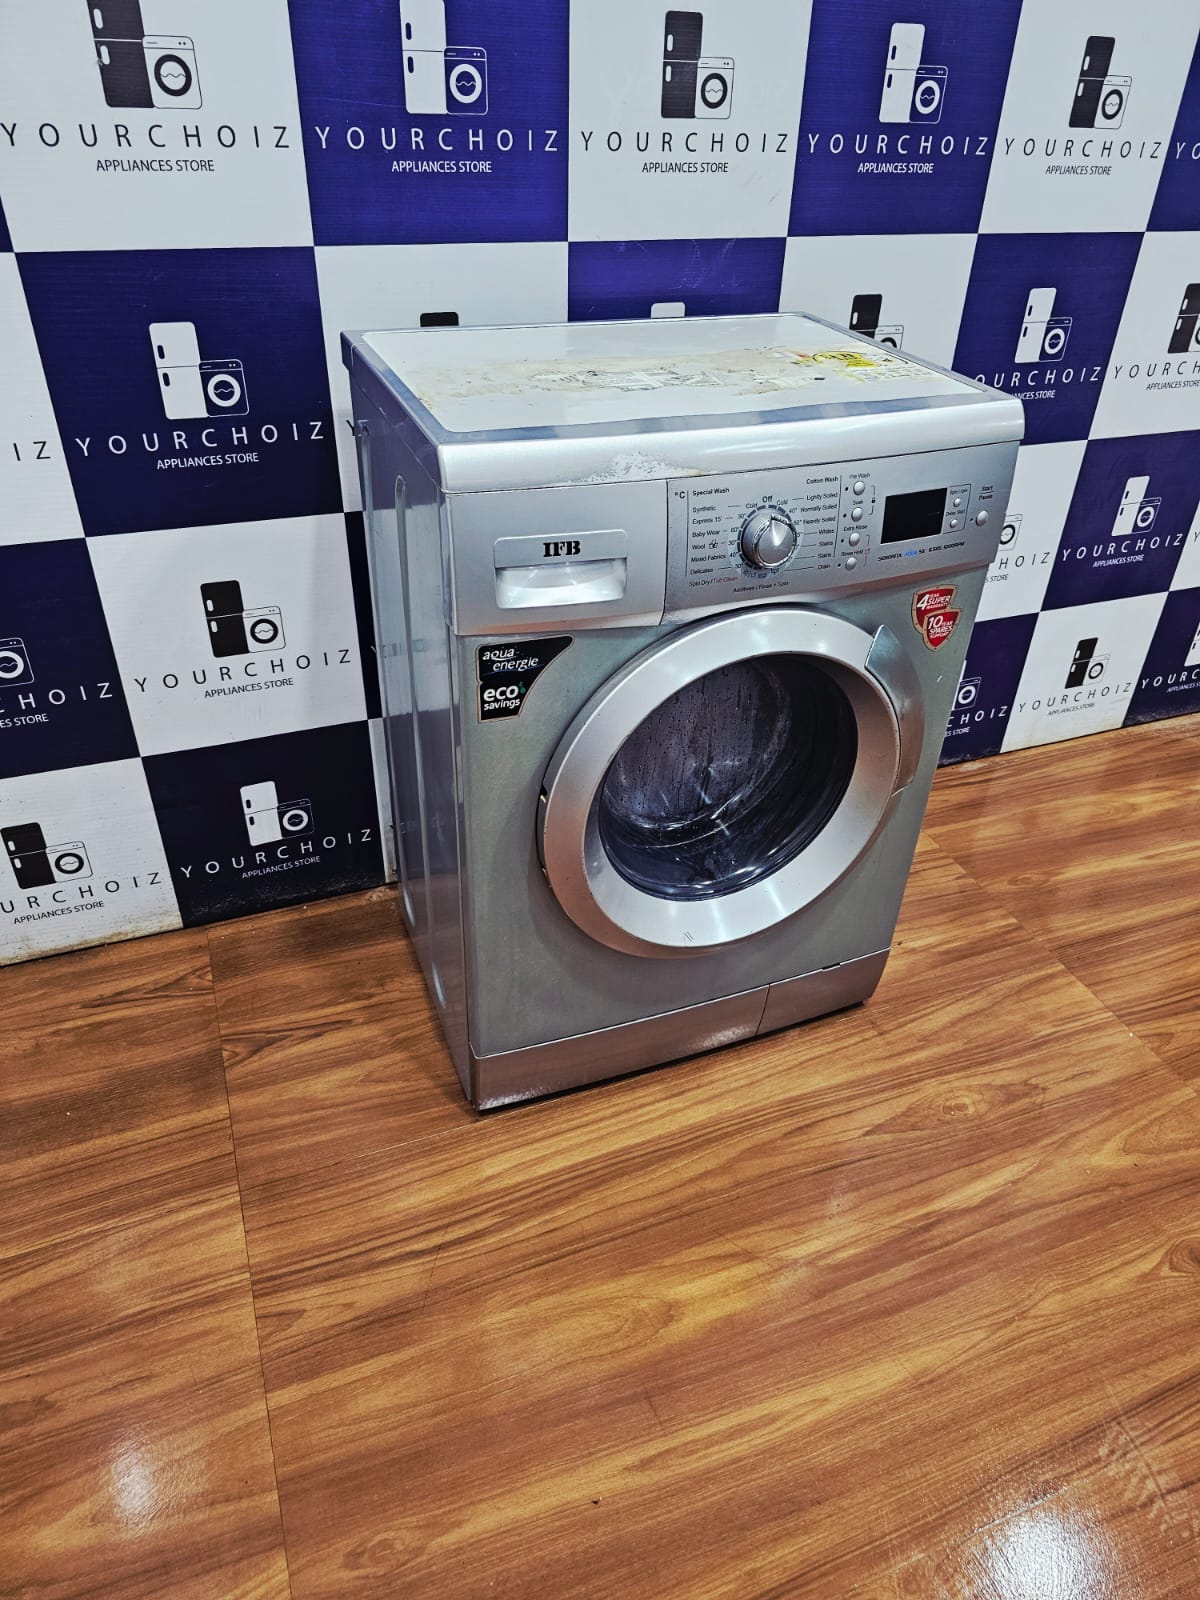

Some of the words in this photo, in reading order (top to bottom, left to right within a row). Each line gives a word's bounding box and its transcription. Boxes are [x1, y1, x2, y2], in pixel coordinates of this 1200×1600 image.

[0, 123, 290, 149] YOURCHOIZ
[315, 127, 558, 152] YOURCHOIZ
[580, 131, 788, 153] YOURCHOIZ
[808, 134, 988, 156] YOURCHOIZ
[1005, 138, 1162, 160] YOURCHOIZ
[96, 160, 173, 172] APPLIANCES
[175, 160, 215, 173] STORE
[392, 161, 457, 173] APPLIANCES
[458, 161, 492, 173] STORE
[642, 162, 698, 173] APPLIANCES
[699, 162, 728, 173] STORE
[857, 162, 907, 174] APPLIANCES
[908, 163, 934, 174] STORE
[1045, 165, 1088, 175] APPLIANCES
[1089, 165, 1112, 176] STORE
[1146, 381, 1181, 390] APPLIANCES
[1035, 389, 1056, 399] STORE
[75, 421, 324, 457] YOURCHOIZ
[156, 455, 223, 470] APPLIANCES
[225, 452, 260, 465] STORE
[762, 495, 773, 503] Off
[543, 541, 581, 557] IFB
[1062, 533, 1184, 561] YOURCHOIZ
[1093, 556, 1126, 568] APPLIANCES
[1126, 554, 1144, 564] STORE
[916, 593, 929, 610] 4
[928, 615, 943, 630] 10
[134, 649, 351, 693] YOURCHOIZ
[493, 656, 538, 671] energie
[204, 685, 262, 698] APPLIANCES
[263, 677, 294, 690] STORE
[483, 685, 519, 701] eco
[483, 698, 520, 711] savings
[1018, 682, 1132, 713] YOURCHOIZ
[14, 713, 49, 726] STORE
[181, 829, 372, 879] YOURCHOIZ
[242, 863, 291, 879] APPLIANCES
[291, 855, 321, 869] STORE
[13, 907, 73, 925] APPLIANCES
[74, 900, 105, 913] STORE
